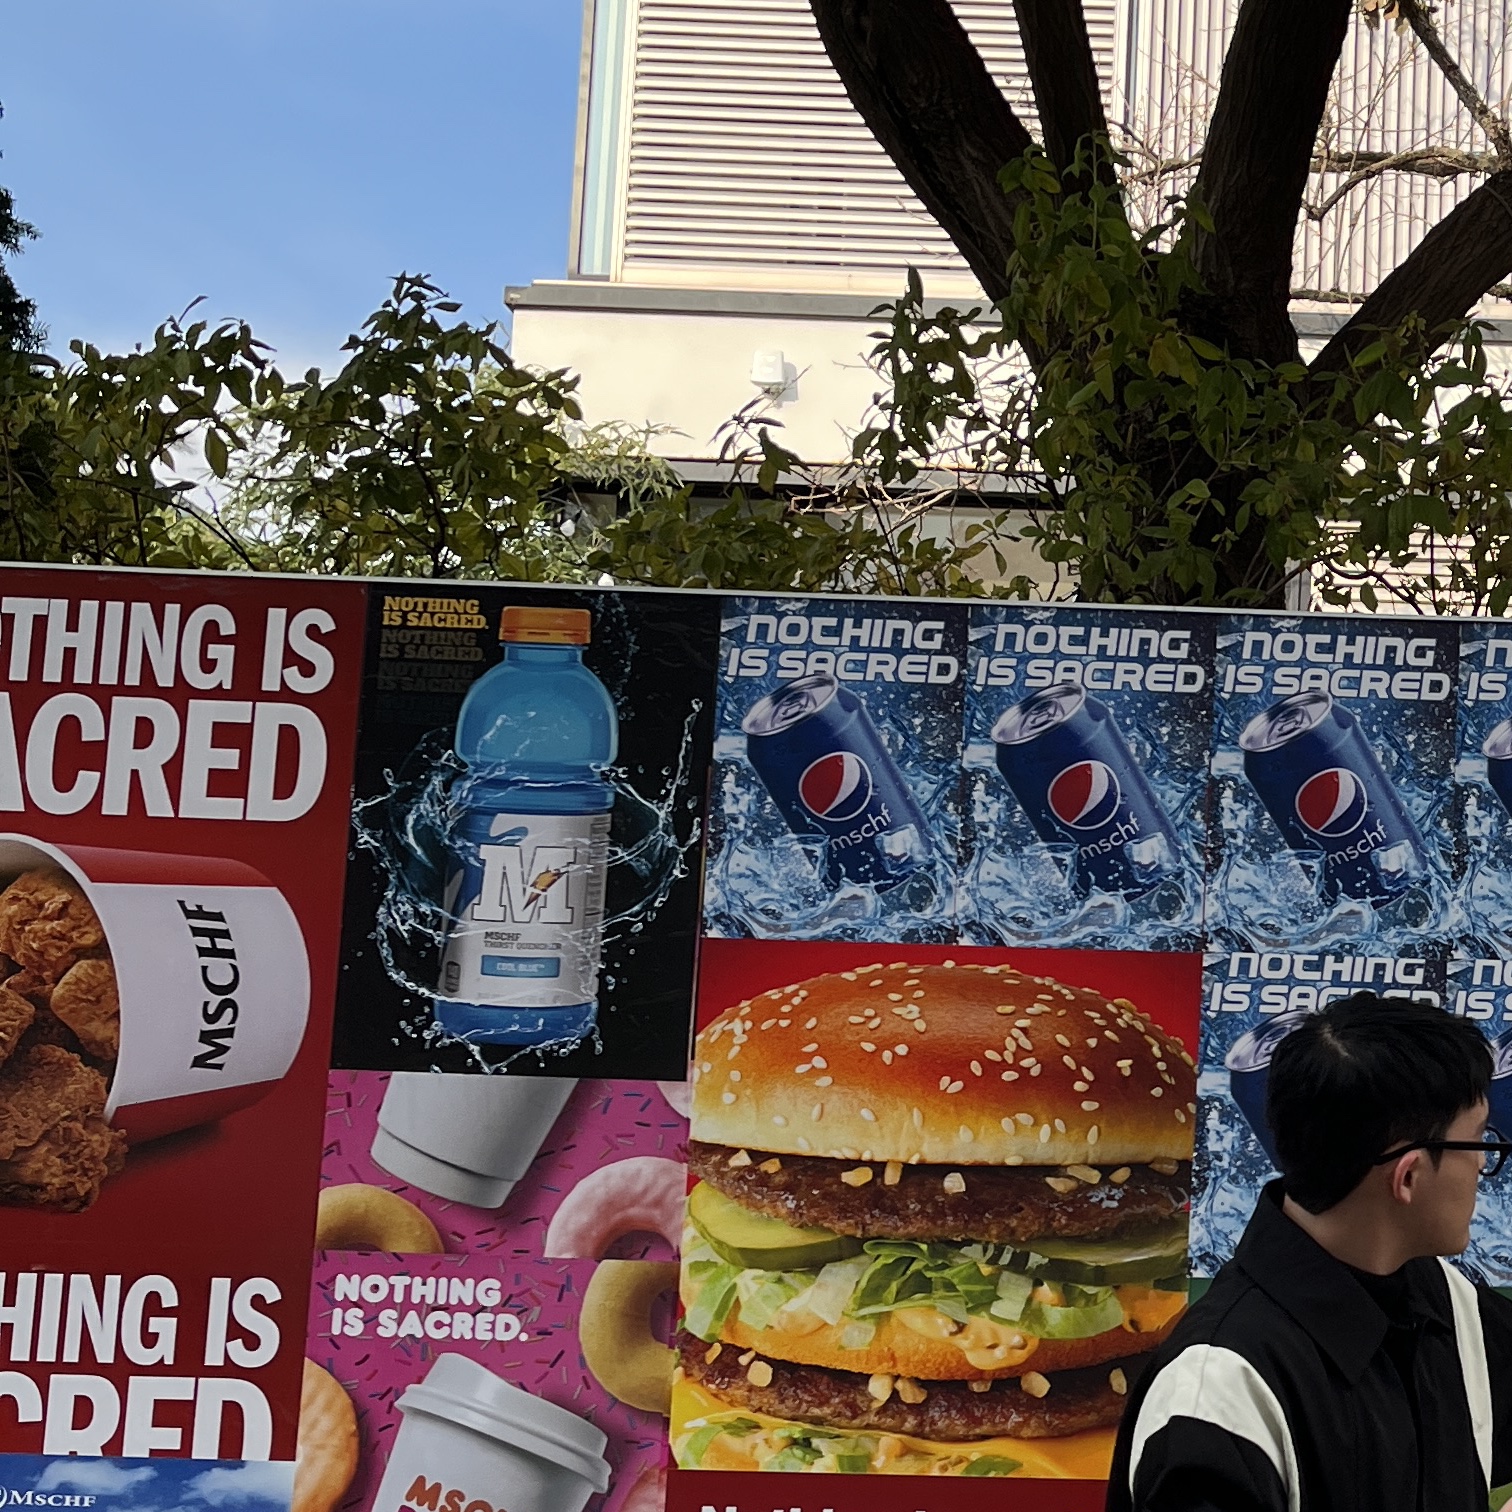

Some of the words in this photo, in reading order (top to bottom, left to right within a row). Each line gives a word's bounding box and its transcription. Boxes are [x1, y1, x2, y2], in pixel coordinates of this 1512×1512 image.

[382, 611, 402, 626] IS
[406, 612, 489, 629] SACRED.
[383, 596, 479, 613] NOTHING
[0, 597, 236, 690] THING
[262, 607, 337, 694] IS
[381, 628, 477, 646] NOTHING
[745, 614, 946, 650] NOTHING
[993, 623, 1191, 659] NOTHING
[1241, 631, 1437, 667] NOTHING
[380, 643, 399, 658] IS
[726, 647, 768, 678] IS
[777, 649, 959, 685] SACRED
[975, 656, 1016, 687] IS
[1025, 658, 1205, 693] SACRED
[1223, 664, 1269, 695] IS
[1272, 667, 1450, 701] SACRED
[1467, 672, 1506, 701] IS
[830, 804, 892, 852] mschf
[1080, 813, 1141, 860] mschf
[1327, 819, 1388, 868] mschf
[177, 899, 240, 1071] MSCHF
[1228, 952, 1426, 984] NOTHING
[1209, 982, 1251, 1012] IS
[1455, 990, 1494, 1020] IS
[335, 1274, 501, 1306] NOTHING
[204, 1277, 282, 1368] IS
[331, 1308, 364, 1336] IS
[376, 1309, 529, 1342] SACRED.
